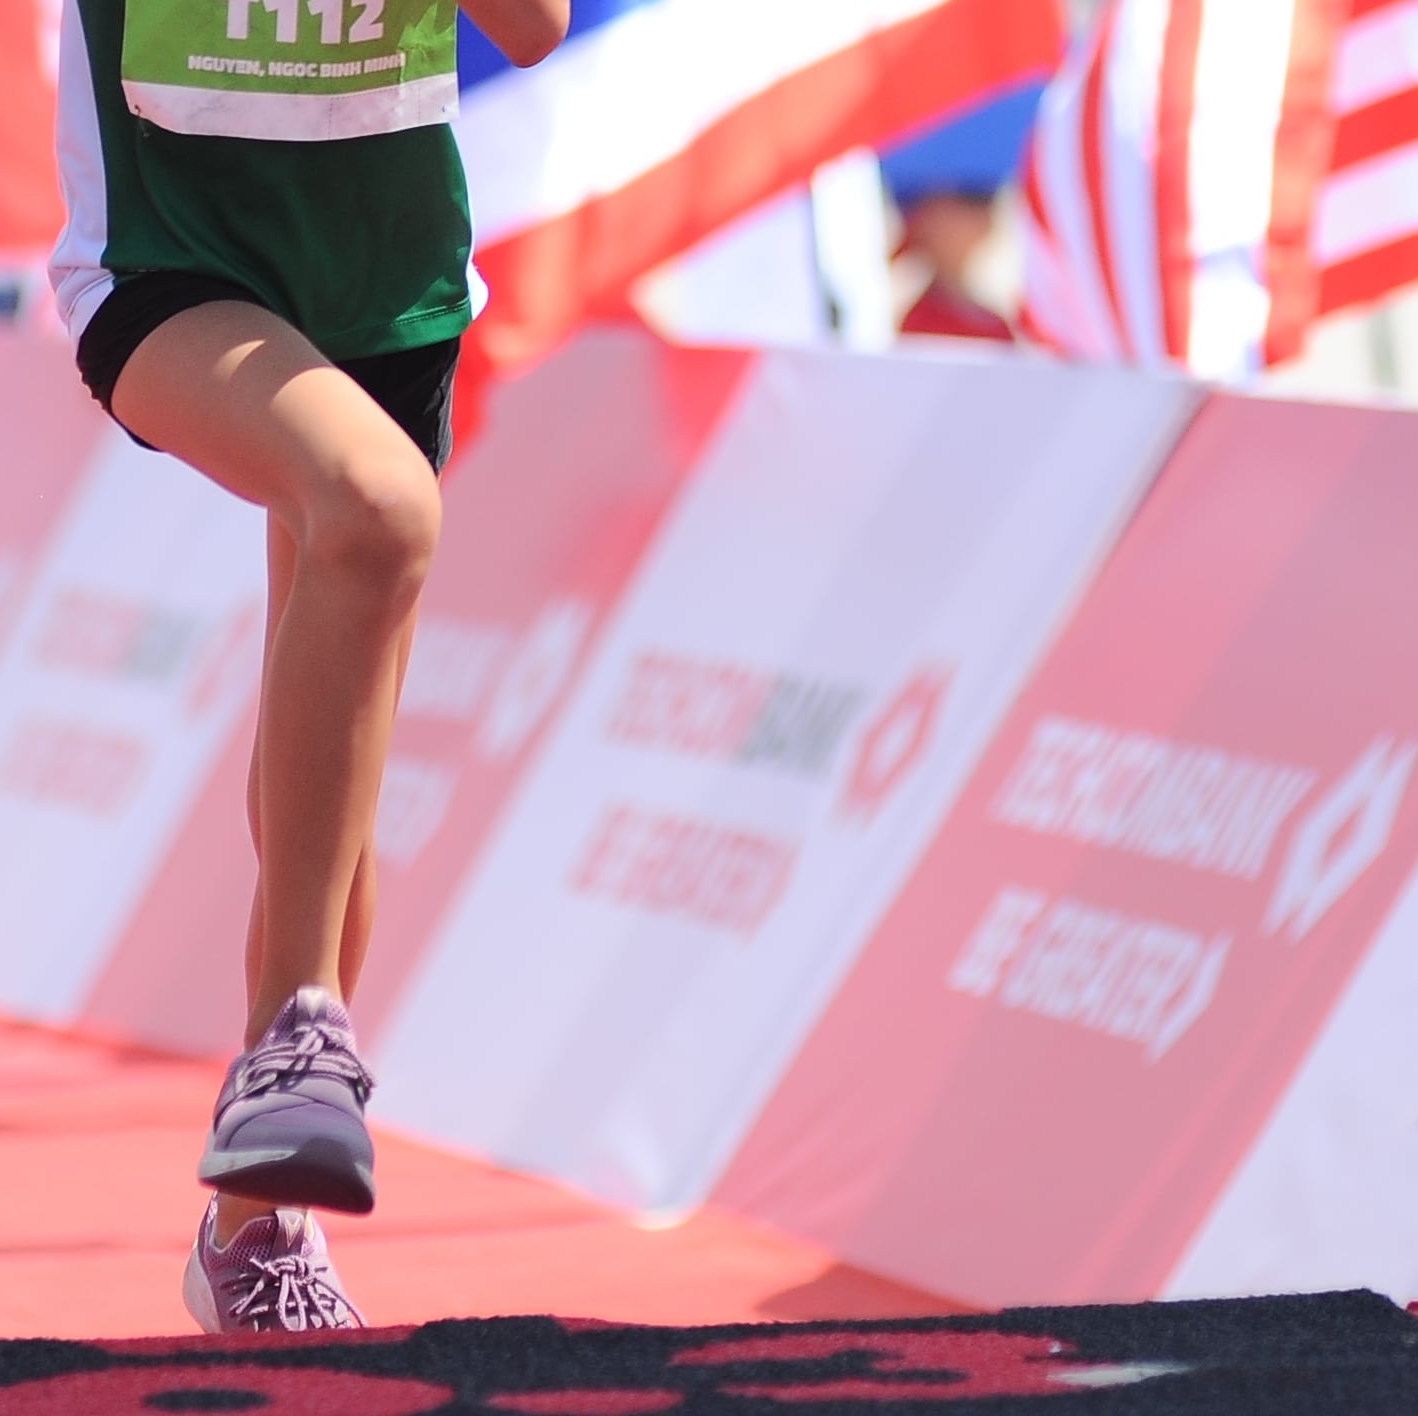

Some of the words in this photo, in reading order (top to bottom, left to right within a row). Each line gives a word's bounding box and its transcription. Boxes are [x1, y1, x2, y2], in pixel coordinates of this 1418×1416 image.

[187, 55, 266, 76] NGUYEN,
[269, 61, 318, 77] NGOC
[320, 61, 362, 77] BINH
[364, 53, 406, 73] MINH
